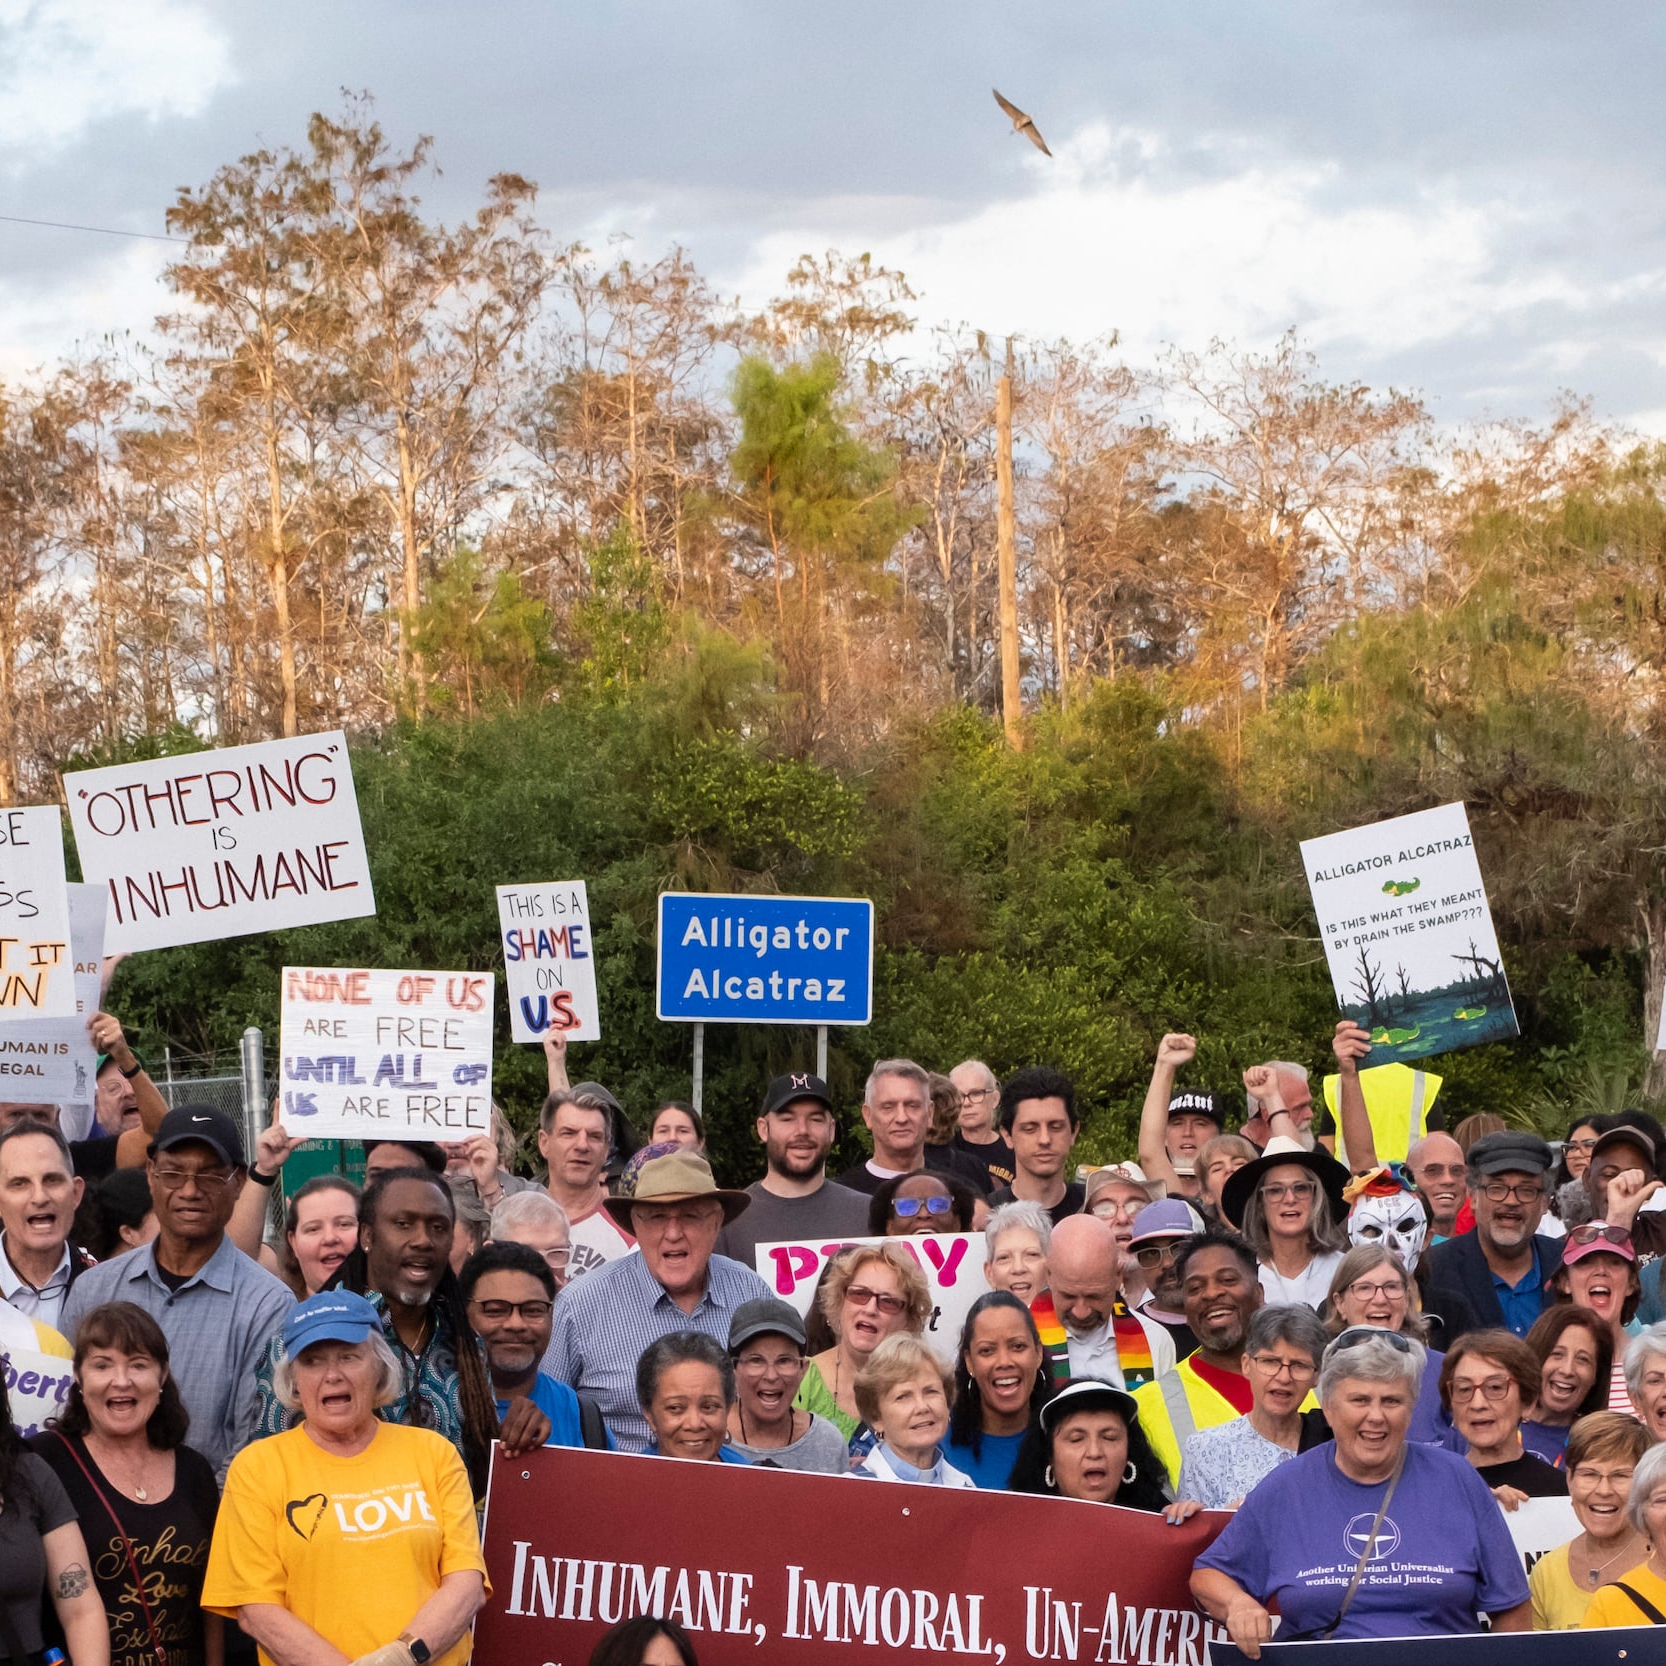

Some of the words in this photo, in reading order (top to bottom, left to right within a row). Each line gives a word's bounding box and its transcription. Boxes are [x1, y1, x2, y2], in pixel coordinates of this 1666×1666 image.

[212, 827, 237, 850] IS
[1314, 854, 1392, 884] ALLIGATOR
[1398, 835, 1472, 866] ALCATRAZ
[108, 841, 359, 924] INHUMANE
[502, 893, 546, 919] THIS
[551, 892, 568, 916] IS
[570, 892, 583, 915] A
[1325, 922, 1338, 935] IS
[1341, 916, 1370, 932] THIS
[1373, 910, 1405, 926] WHAT
[1408, 902, 1439, 919] THEY
[1442, 889, 1483, 912] MEANT
[505, 924, 589, 963] SHAME
[681, 915, 850, 957] Alligator
[1334, 938, 1351, 950] BY
[1354, 928, 1389, 948] DRAIN
[1392, 923, 1415, 938] THE
[1418, 907, 1483, 934] SWAMP???
[29, 944, 65, 967] IT
[286, 971, 373, 1007] NONE
[395, 977, 437, 1006] OF
[446, 977, 487, 1012] US
[535, 963, 563, 990] ON
[683, 968, 846, 1003] Alcatraz
[520, 990, 582, 1034] U.S.
[52, 1042, 69, 1054] IS
[303, 1017, 349, 1039] ARE
[376, 1016, 466, 1051] FREE
[284, 1055, 366, 1086] UNTIL
[372, 1053, 439, 1090] ALL
[452, 1063, 488, 1086] OF
[284, 1090, 320, 1117] US
[341, 1097, 390, 1120] ARE
[405, 1096, 487, 1130] FREE
[334, 1490, 436, 1532] LOVE
[118, 1571, 188, 1607] Love
[1295, 1566, 1335, 1578] Another
[1391, 1562, 1454, 1574] Universalist
[1305, 1576, 1349, 1587] working
[1370, 1575, 1402, 1584] Social
[1404, 1573, 1443, 1586] Justice
[504, 1540, 768, 1646] INHUMANE,
[782, 1564, 1009, 1666] IMMORAL,
